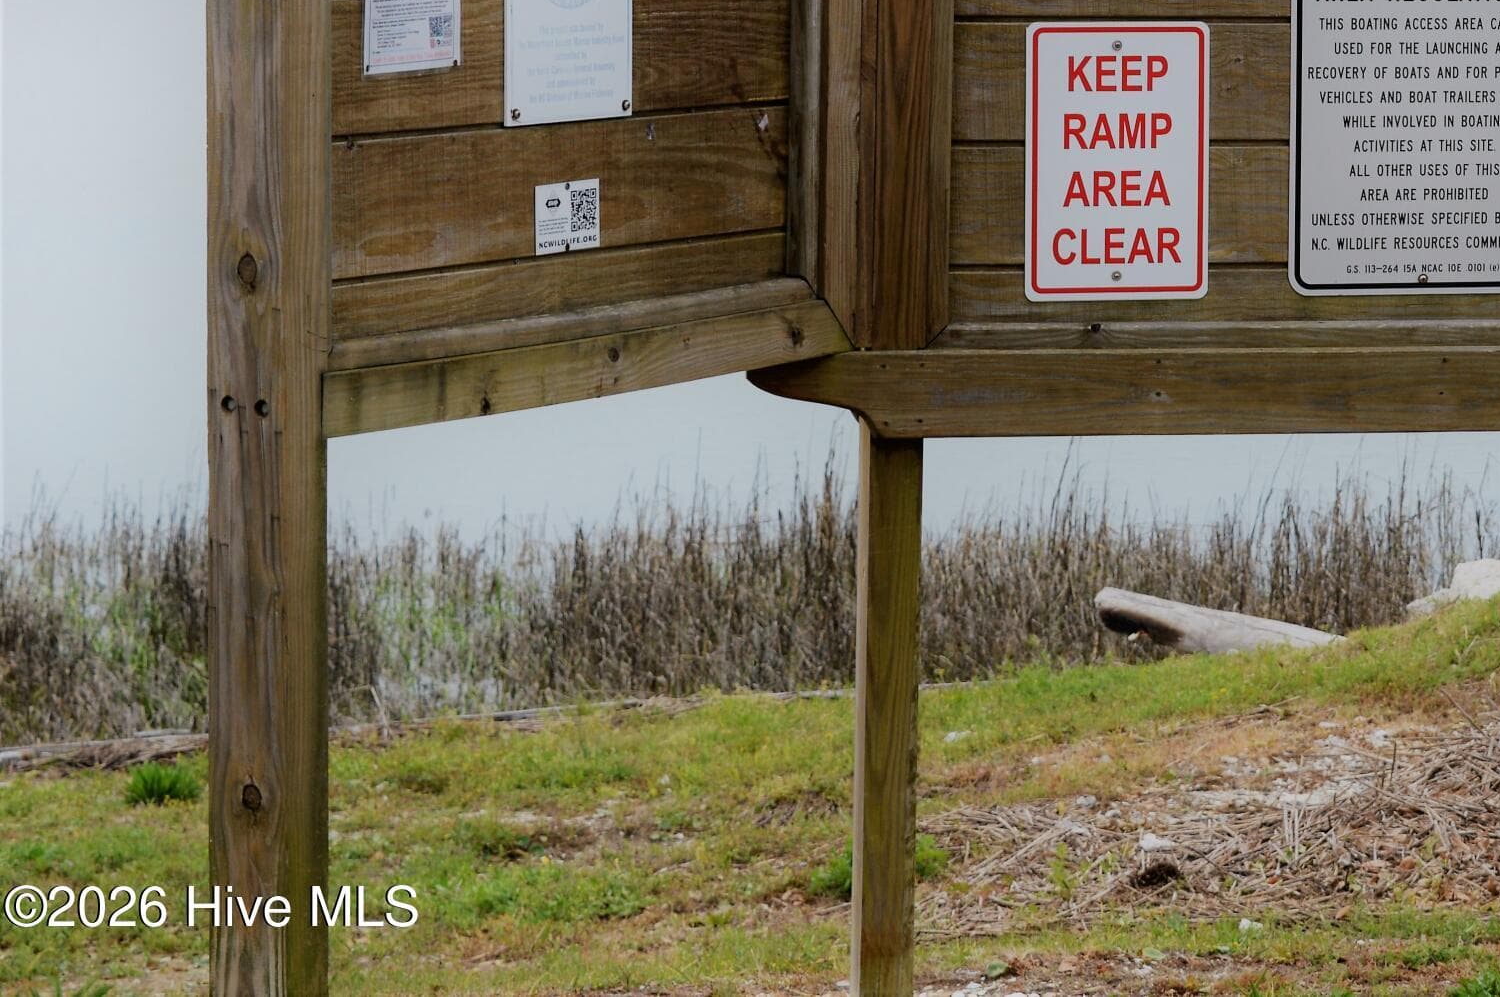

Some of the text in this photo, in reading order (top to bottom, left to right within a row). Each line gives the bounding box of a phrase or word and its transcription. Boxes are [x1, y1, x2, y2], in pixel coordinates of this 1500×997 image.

[1319, 18, 1344, 31] THIS
[1351, 18, 1398, 31] BOATING
[1405, 18, 1448, 31] ACCESS
[1455, 18, 1483, 31] AREA
[1334, 42, 1363, 55] USED
[1371, 42, 1392, 55] FOR
[1399, 42, 1419, 55] THE
[1426, 42, 1488, 55] LAUNCHING
[1067, 56, 1168, 92] KEEP
[1308, 66, 1366, 79] RECOVERY
[1374, 66, 1388, 79] OF
[1395, 66, 1430, 79] BOATS
[1437, 66, 1459, 79] AND
[1466, 66, 1487, 79] FOR
[1319, 91, 1373, 103] VEHICLES
[1380, 91, 1401, 103] AND
[1409, 91, 1436, 103] BOAT
[1443, 91, 1496, 103] TRAILERS
[1343, 115, 1376, 128] WHILE
[1383, 115, 1437, 128] INVOLVED
[1444, 115, 1454, 128] IN
[1063, 113, 1172, 149] RAMP
[1354, 140, 1413, 152] ACTIVITIES
[1420, 140, 1435, 152] AT
[1439, 140, 1463, 152] THIS
[1349, 164, 1500, 177] ALL OTHER USES OF THIS
[1063, 171, 1170, 207] AREA
[1360, 188, 1488, 201] AREA ARE PROHIBITED
[1312, 212, 1355, 226] UNLESS
[1362, 212, 1424, 226] OTHERWISE
[1432, 212, 1488, 226] SPECIFIED
[539, 235, 597, 248] NCWILDLIFE.ORG
[1052, 228, 1181, 265] CLEAR
[1312, 236, 1330, 250] N.C.
[1337, 236, 1387, 250] WILDLIFE
[1393, 236, 1459, 250] RESOURCES
[1347, 264, 1443, 274] G.S. 15A NCAC
